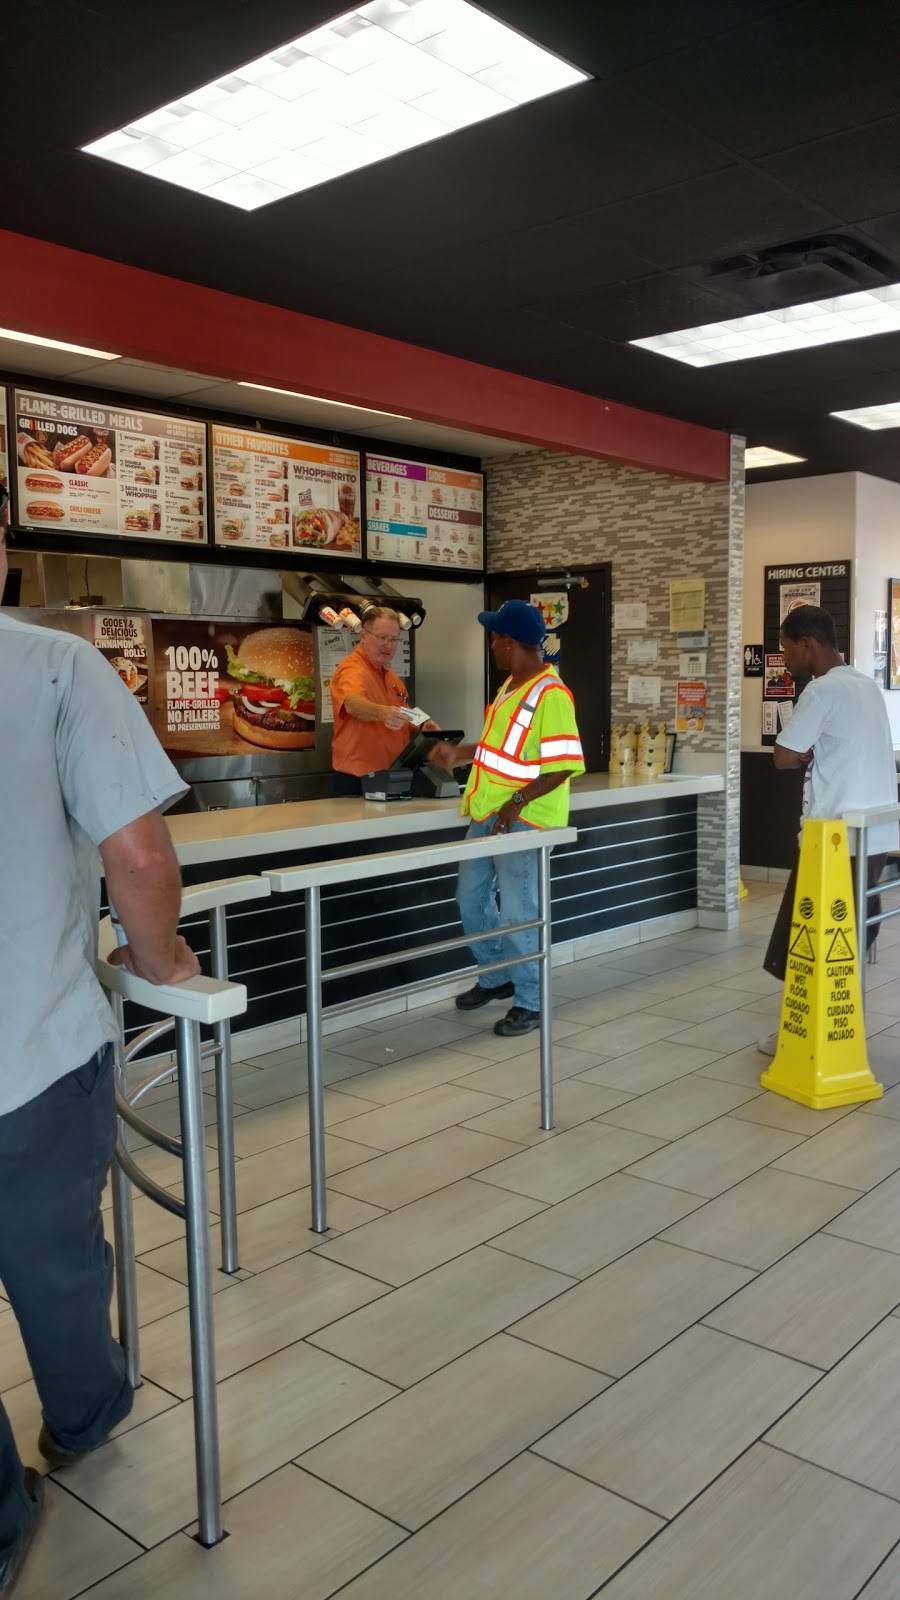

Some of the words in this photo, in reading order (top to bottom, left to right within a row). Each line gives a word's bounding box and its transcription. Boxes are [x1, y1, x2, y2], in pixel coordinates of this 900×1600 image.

[20, 397, 105, 424] FLAME-GRILLED
[109, 414, 143, 432] MEALS
[19, 418, 54, 433] GRILLED
[57, 424, 78, 436] DOGS
[215, 432, 243, 448] OTHER
[246, 438, 288, 456] FAVORITES
[368, 459, 407, 476] BEVERAGES
[429, 470, 446, 483] SIDES
[69, 480, 88, 488] CLASSIC
[126, 491, 157, 500] WHOPPER
[429, 507, 459, 521] DESSERTS
[368, 522, 390, 532] SHAKES
[768, 568, 804, 580] HIRING
[806, 565, 846, 578] CENTER
[103, 618, 127, 628] GOOEY
[129, 620, 134, 628] &
[102, 627, 137, 637] DELICIOUS
[95, 640, 134, 648] CINNAMON
[124, 649, 145, 658] ROLLS
[165, 646, 218, 670] 100%
[166, 672, 220, 699] BEEF
[168, 700, 220, 710] FLAME-GRILLED
[168, 710, 182, 723] NO
[184, 710, 220, 722] FILLERS
[178, 723, 220, 731] PRESERVATIVES
[790, 960, 813, 976] CAUTION
[827, 965, 854, 977] CAUTION
[795, 974, 805, 985] WET
[834, 978, 847, 989] WET
[790, 984, 807, 998] FLOOR
[831, 990, 850, 1002] FLOOR
[785, 997, 809, 1014] CUIDADO
[827, 1004, 854, 1016] CUIDADO
[790, 1011, 802, 1024] PISO
[834, 1017, 848, 1028] PISO
[784, 1020, 807, 1038] MOJADO
[828, 1028, 854, 1041] MOJADO
